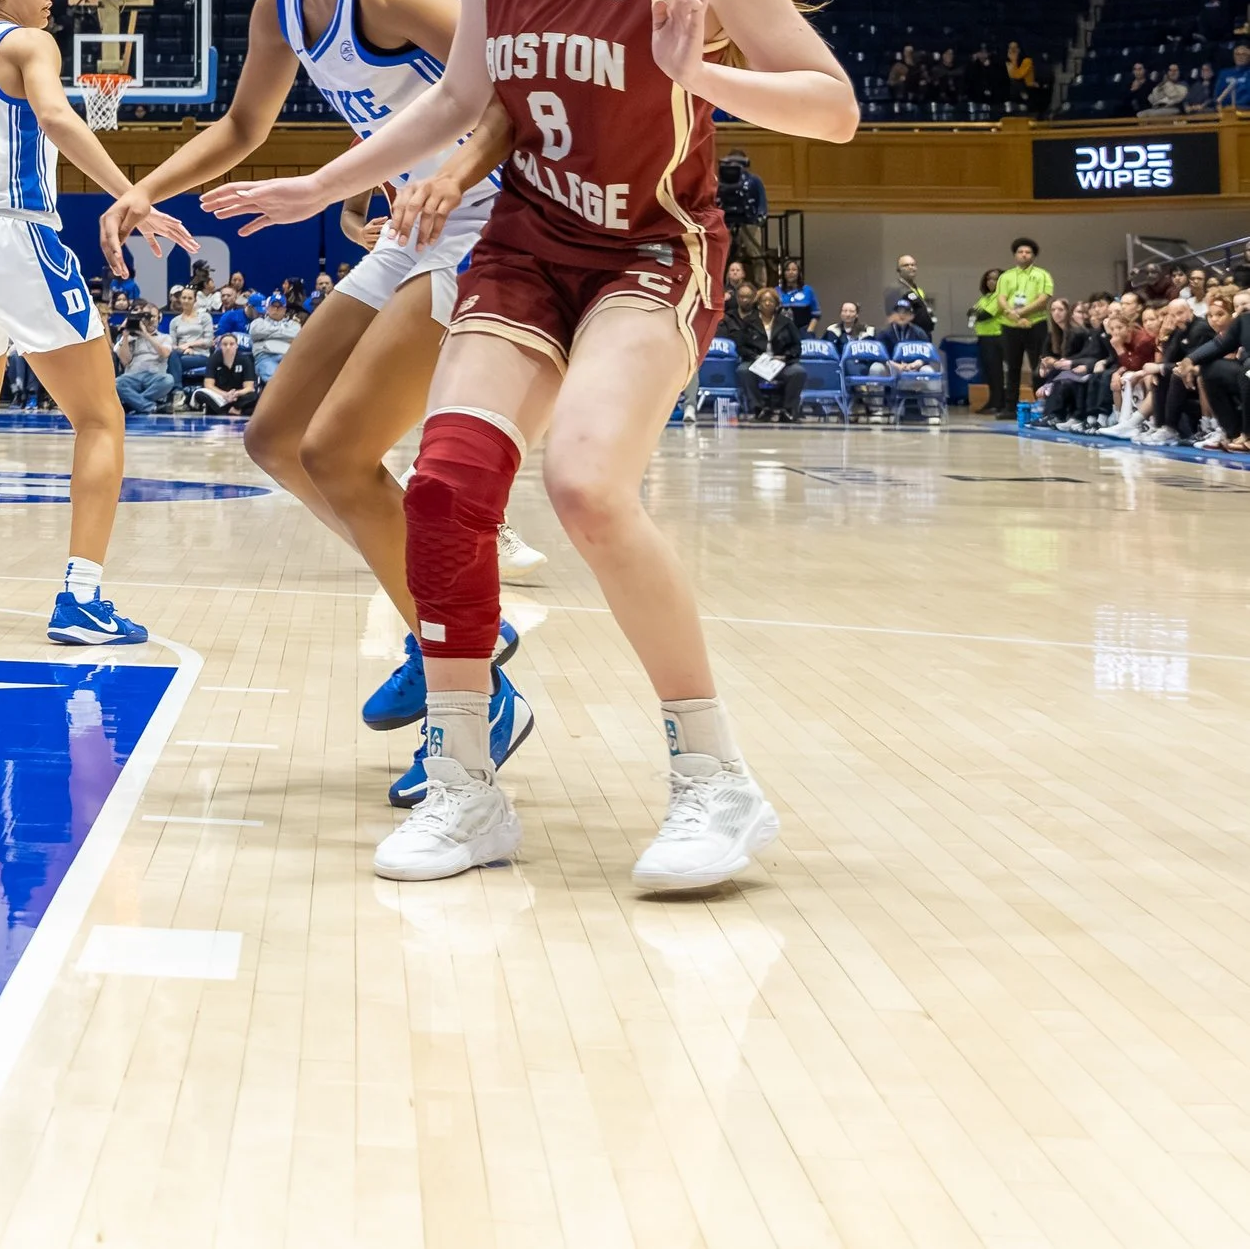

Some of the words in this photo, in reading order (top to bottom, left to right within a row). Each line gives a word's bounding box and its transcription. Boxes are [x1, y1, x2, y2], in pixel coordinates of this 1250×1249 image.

[486, 32, 626, 91] BOSTON
[321, 88, 393, 124] UKE
[526, 91, 573, 162] 8
[1075, 143, 1173, 170] DUDE
[513, 149, 630, 230] COLLEGE
[1076, 168, 1174, 190] WIPES
[238, 333, 250, 348] KE
[801, 340, 830, 355] DUKE
[851, 340, 879, 356] DUKE
[902, 341, 930, 357] DUKE
